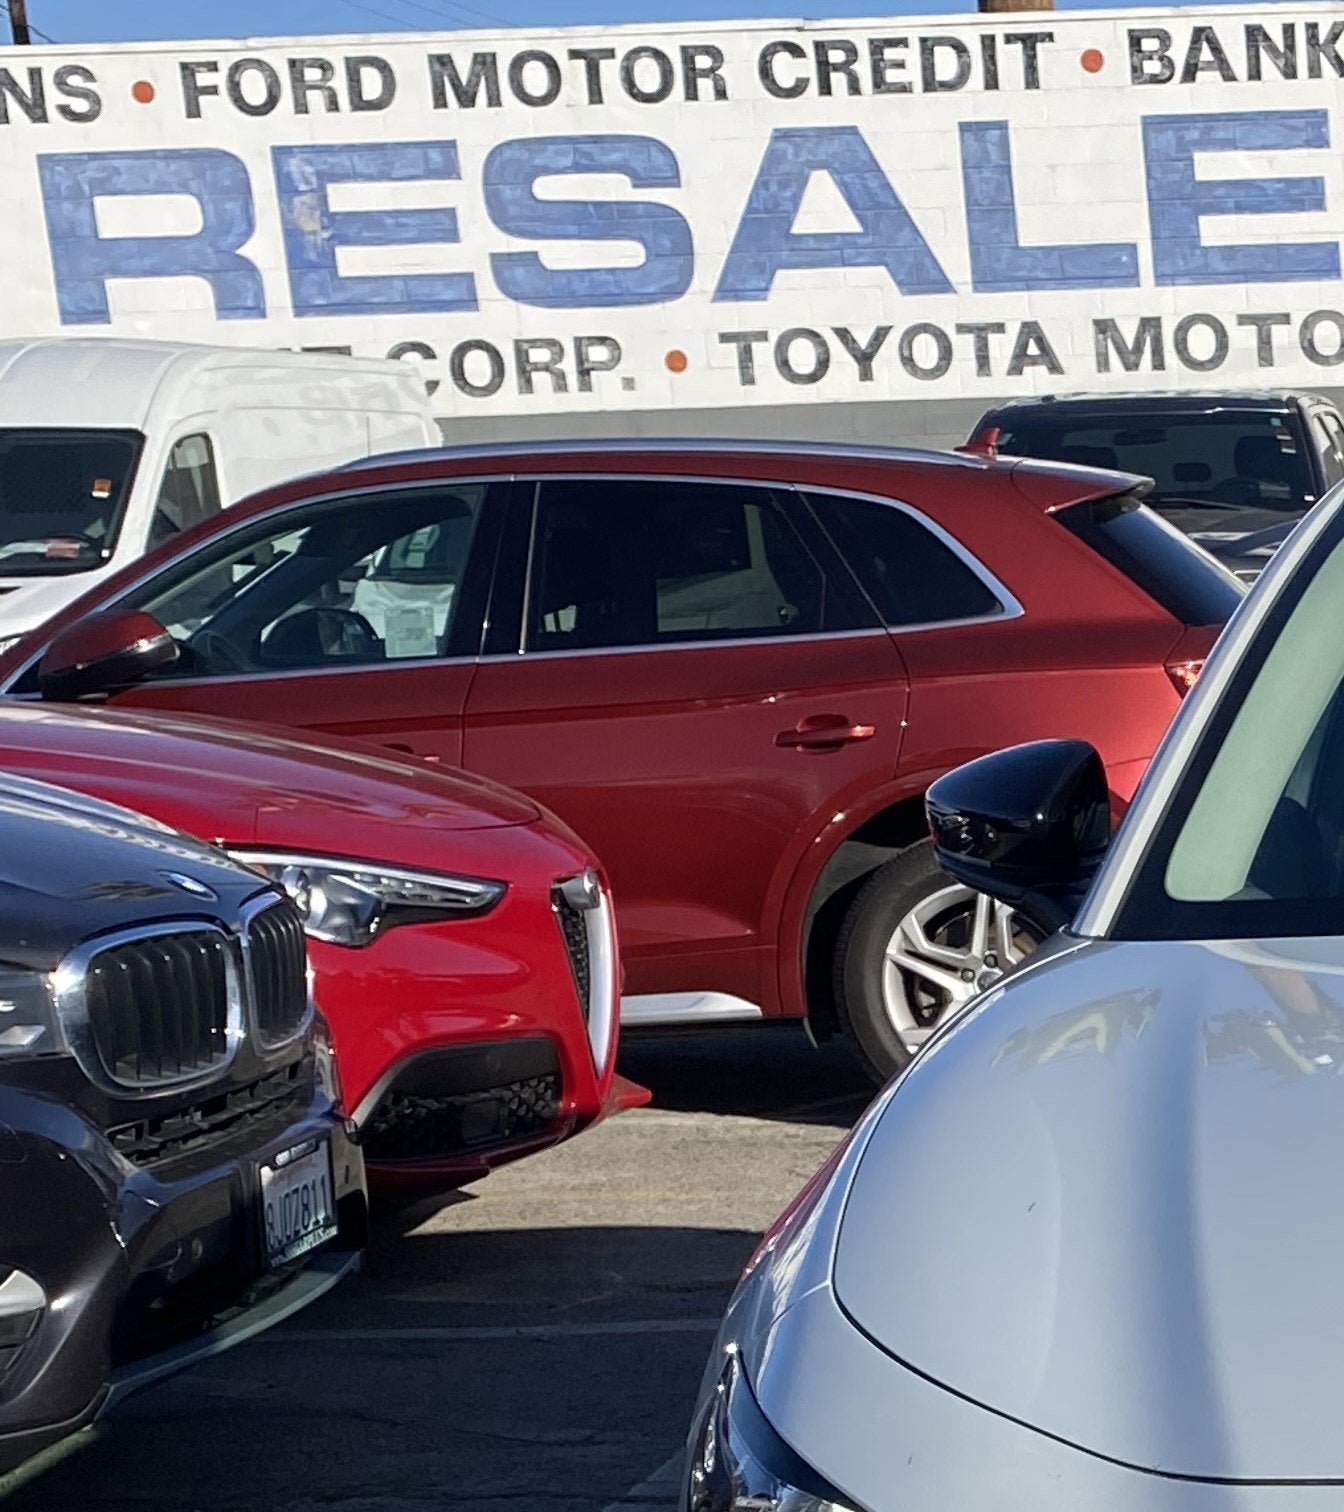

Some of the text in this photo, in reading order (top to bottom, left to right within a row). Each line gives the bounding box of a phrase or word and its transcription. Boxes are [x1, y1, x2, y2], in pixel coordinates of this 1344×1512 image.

[179, 56, 396, 118] FORD
[429, 45, 729, 109] MOTOR
[757, 31, 1055, 99] CREDIT
[37, 108, 1342, 325] RESALE
[720, 320, 1065, 386] TOYOTA
